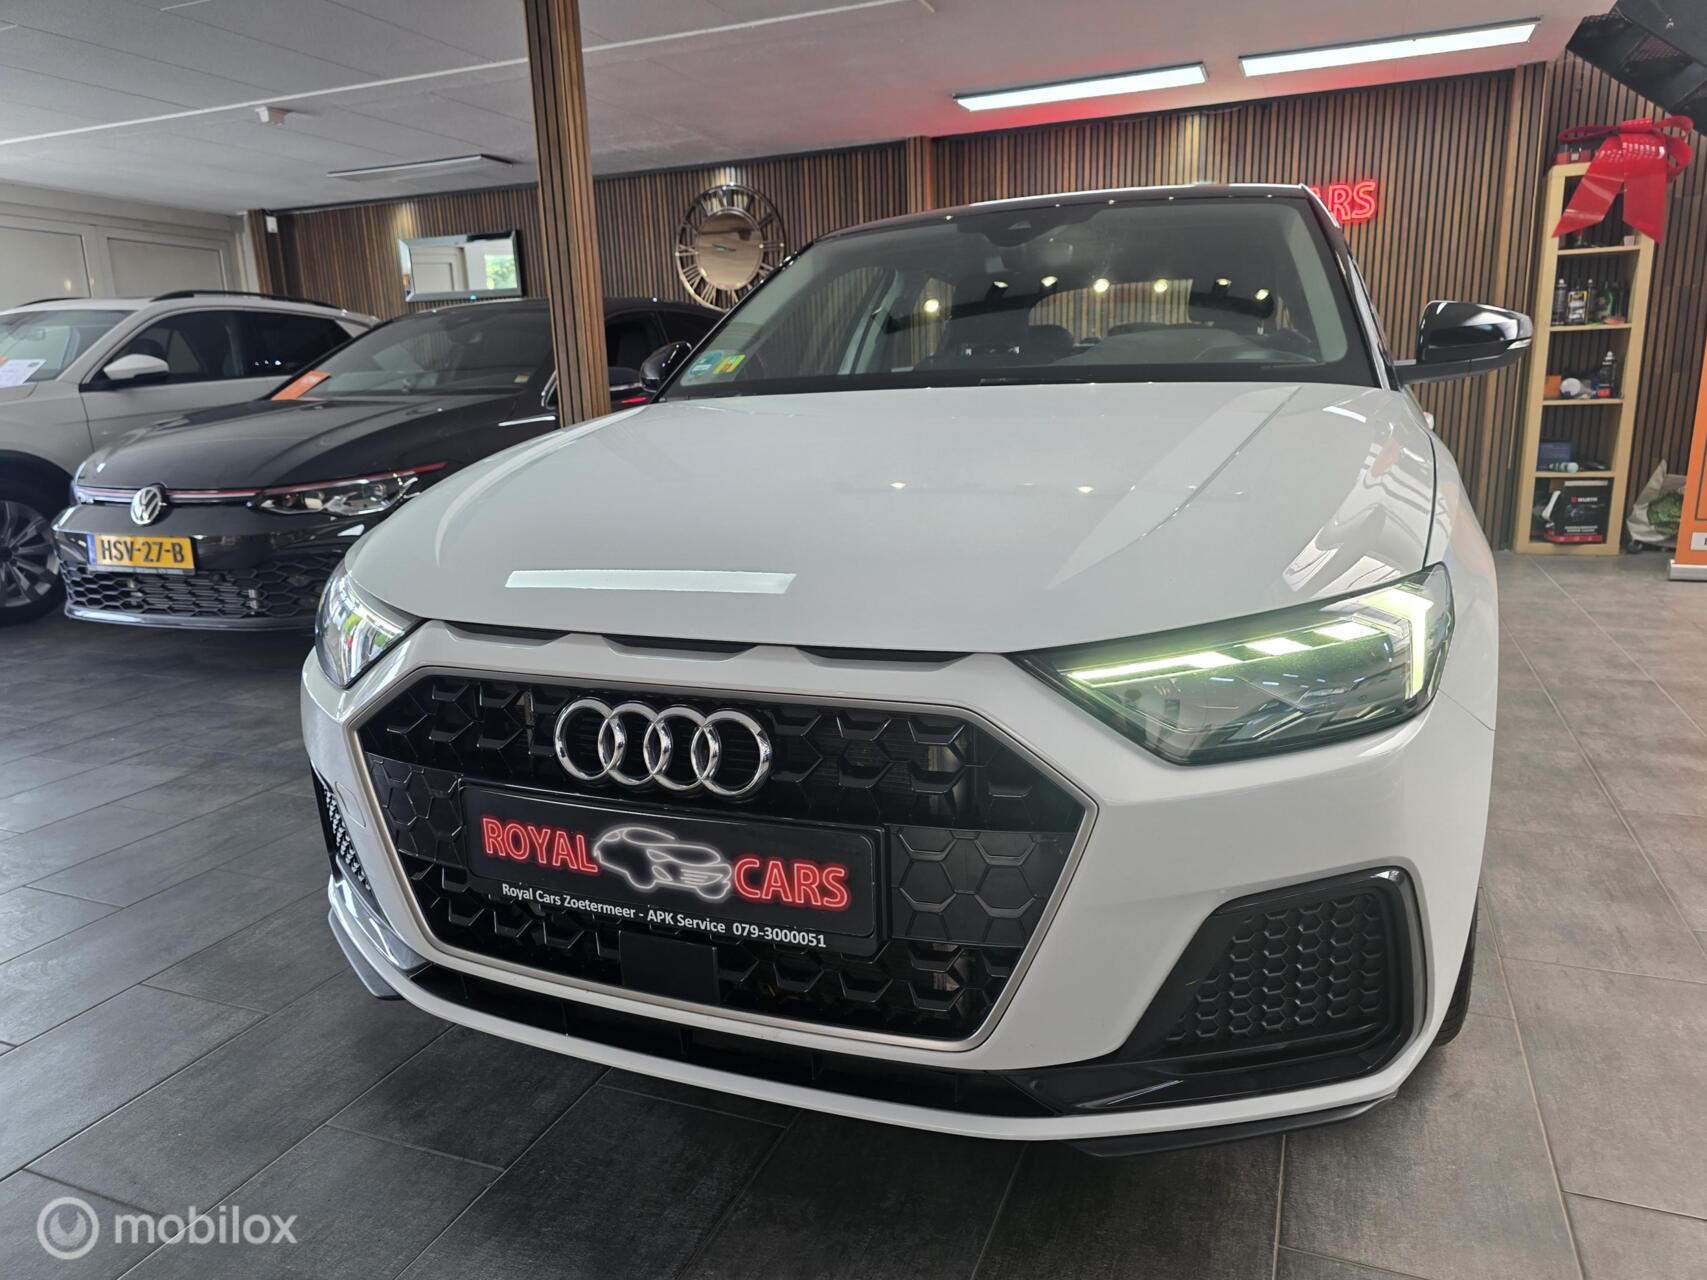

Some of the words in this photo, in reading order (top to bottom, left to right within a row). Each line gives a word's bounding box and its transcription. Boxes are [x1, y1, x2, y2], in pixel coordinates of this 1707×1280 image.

[100, 539, 185, 564] HSV-27-B
[482, 817, 599, 873] ROYAL
[734, 857, 849, 909] CARS
[502, 882, 533, 901] Royal
[535, 890, 561, 906] Cars
[563, 894, 636, 919] Zoetermeer
[647, 909, 674, 926] APK
[677, 913, 726, 934] Service
[733, 922, 827, 949] 079-3000051
